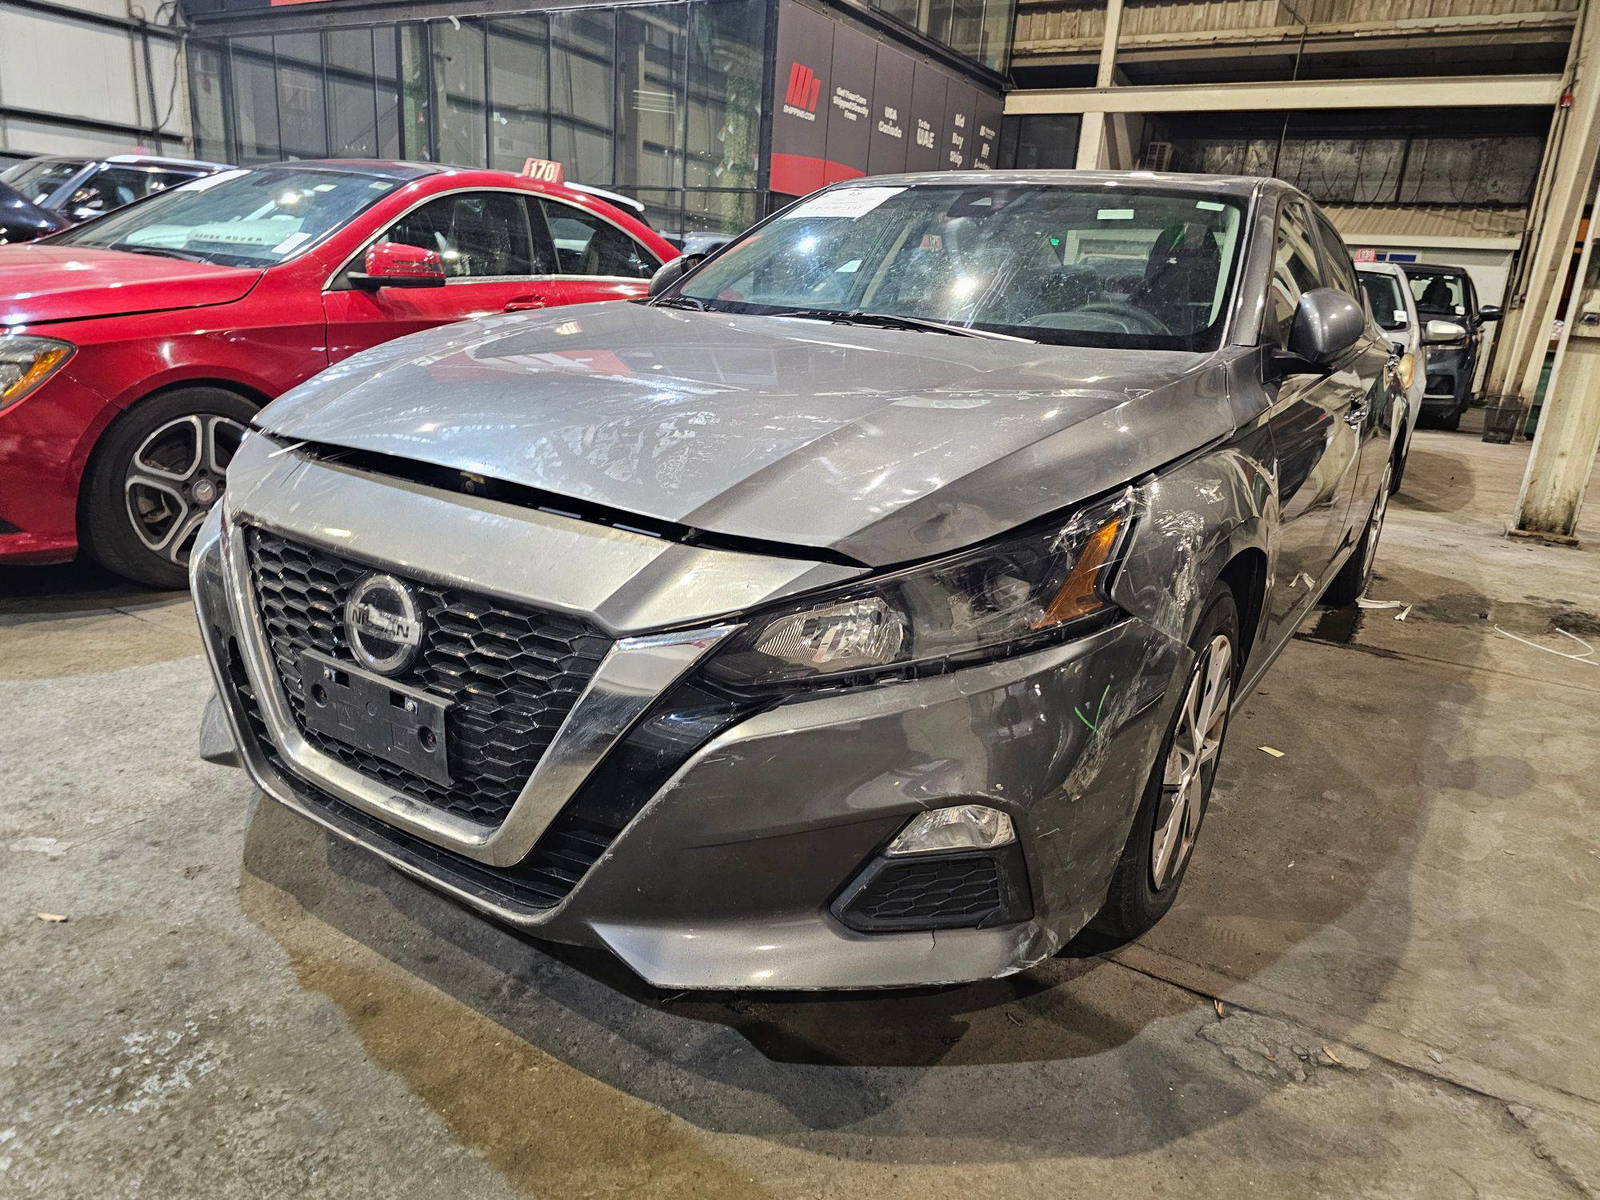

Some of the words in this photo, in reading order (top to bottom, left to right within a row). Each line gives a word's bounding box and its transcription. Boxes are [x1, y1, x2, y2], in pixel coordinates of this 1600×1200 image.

[878, 120, 902, 138] Canada
[916, 127, 935, 149] UAE
[530, 162, 555, 182] 170
[352, 608, 409, 638] NIAN
